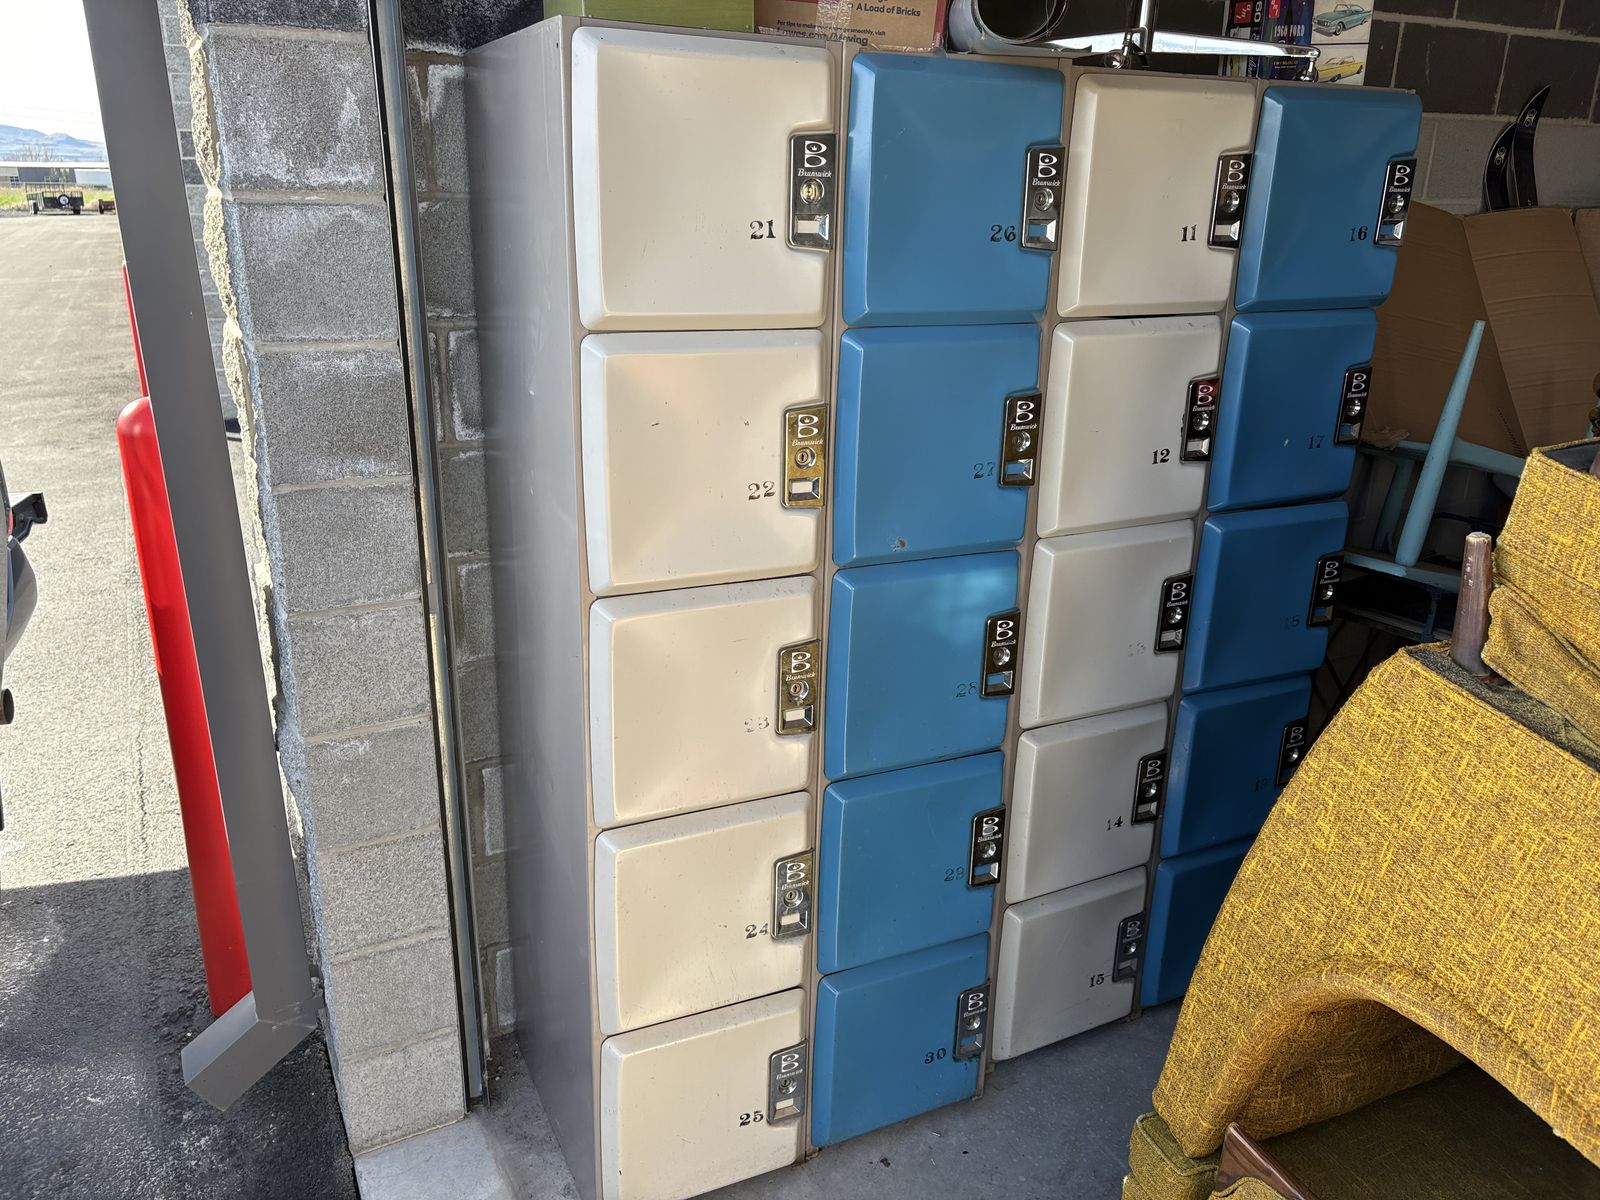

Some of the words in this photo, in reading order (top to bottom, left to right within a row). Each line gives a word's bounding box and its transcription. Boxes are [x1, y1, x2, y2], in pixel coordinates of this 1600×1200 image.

[856, 3, 863, 11] A
[864, 4, 885, 13] Load
[896, 7, 921, 17] Bricks
[1289, 25, 1305, 37] FORD
[797, 168, 832, 178] Brunswick
[1032, 178, 1061, 186] Brunswick
[750, 219, 776, 239] 21
[990, 225, 1017, 242] 26
[1181, 224, 1197, 241] 11
[1350, 226, 1368, 242] 16
[1152, 448, 1170, 464] 12
[748, 481, 776, 500] 22
[786, 672, 815, 681] Brunswick
[956, 682, 977, 697] 28
[1106, 816, 1123, 830] 14
[745, 923, 769, 939] 24
[1089, 974, 1105, 987] 15
[925, 1048, 946, 1064] 30
[740, 1111, 764, 1127] 25
